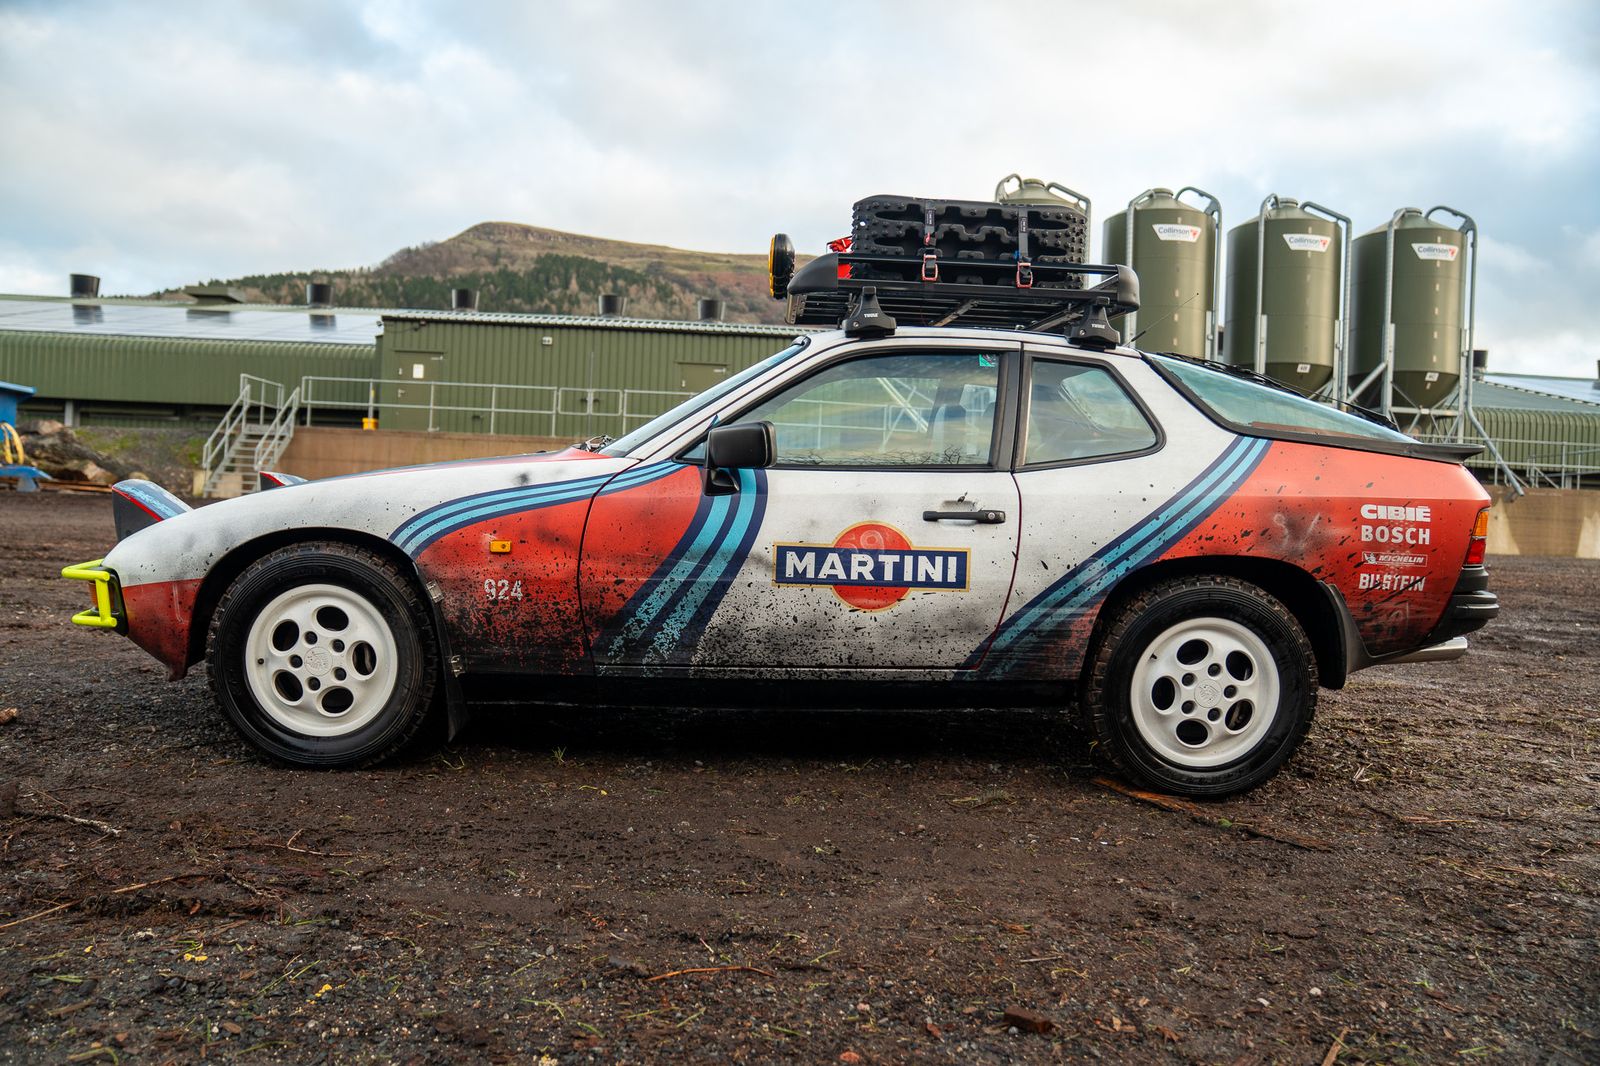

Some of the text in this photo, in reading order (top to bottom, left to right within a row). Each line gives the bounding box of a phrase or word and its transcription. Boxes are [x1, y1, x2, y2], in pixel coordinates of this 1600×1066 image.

[1361, 525, 1430, 545] BOSCH
[785, 551, 958, 583] MARTINI
[1379, 554, 1425, 563] MICHELIN
[484, 579, 523, 600] 924
